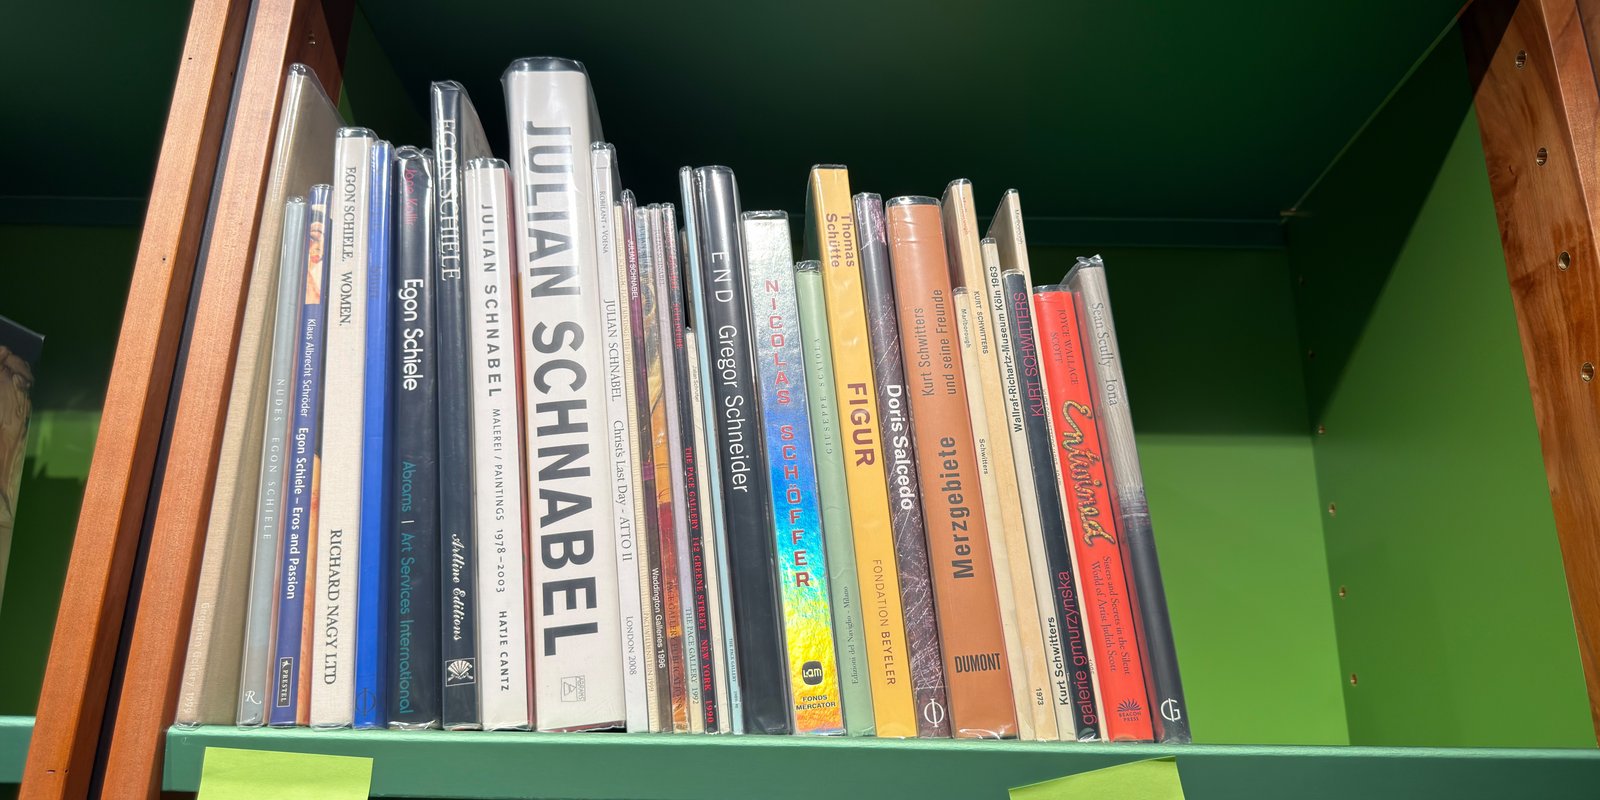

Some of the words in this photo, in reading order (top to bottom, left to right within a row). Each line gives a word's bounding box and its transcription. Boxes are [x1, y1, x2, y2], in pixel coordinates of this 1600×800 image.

[438, 118, 459, 183] EGON
[344, 166, 357, 202] EGON
[525, 121, 582, 298] JULIAN
[598, 190, 607, 223] ROBILANT
[341, 205, 355, 262] SCHIELE.
[440, 187, 462, 281] SCHIELE
[481, 204, 497, 272] JULIAN
[627, 239, 635, 263] JULIAN
[826, 213, 842, 268] Schütte
[840, 213, 855, 268] Thomas
[629, 264, 638, 300] SCHNABEL
[656, 252, 665, 286] SCHNABEL
[711, 252, 734, 303] END
[988, 266, 1000, 289] 1963
[339, 271, 354, 327] WOMEN.
[398, 278, 424, 321] Egon
[933, 289, 948, 334] Freunde
[973, 290, 983, 309] KURT
[993, 289, 1004, 311] Köln
[1091, 302, 1108, 329] Sean
[305, 318, 317, 341] Klaus
[603, 299, 618, 338] JULIAN
[977, 311, 989, 355] SCHWITTERS
[1013, 292, 1037, 377] SCHWITTERS
[1056, 308, 1072, 337] JOYCE
[485, 284, 502, 397] SCHNABEL
[716, 324, 740, 387] Gregor
[914, 307, 931, 368] Schwitters
[940, 338, 954, 369] seine
[1050, 331, 1062, 364] SCOTT
[1093, 331, 1113, 368] Scully
[303, 342, 316, 378] Albrecht
[403, 327, 424, 391] Schiele
[608, 342, 622, 402] SCHNABEL
[996, 312, 1023, 433] Wallraf-Richartz-Museum
[1063, 339, 1079, 385] WALLACE
[274, 378, 287, 422] NUDES
[300, 379, 313, 417] Schröder
[921, 374, 935, 396] Kurt
[944, 374, 957, 395] und
[960, 308, 972, 348] Marlborough
[978, 438, 989, 475] Schwitters
[1026, 382, 1045, 417] KURT
[1105, 378, 1119, 407] Iona
[819, 395, 833, 455] GIUSEPPE
[847, 383, 875, 466] FIGUR
[886, 384, 906, 432] Doris
[295, 427, 309, 454] Egon
[491, 408, 502, 452] MALEREI
[724, 395, 750, 492] Schneider
[765, 280, 791, 404] NICOLAS
[778, 426, 810, 588] SCHÖFFER
[268, 437, 281, 473] EGON
[615, 461, 627, 482] Last
[685, 447, 693, 464] THE
[890, 435, 915, 510] Salcedo
[1062, 399, 1116, 546] Entwined
[293, 457, 307, 494] Schiele
[401, 461, 416, 512] Abrams
[493, 464, 505, 521] PAINTINGS
[532, 321, 599, 657] SCHNABEL
[686, 466, 695, 489] PACE
[262, 481, 277, 541] SCHIELE
[614, 485, 629, 506] Day
[688, 491, 699, 530] GALLERY
[939, 436, 975, 579] Merzgebiete
[291, 506, 303, 530] Eros
[619, 516, 632, 549] ATTO
[289, 532, 301, 554] and
[400, 531, 415, 551] Art
[451, 532, 466, 583] Artline
[622, 552, 632, 561] II
[692, 536, 700, 553] 142
[286, 557, 299, 599] Passion
[327, 529, 343, 601] RICHARD
[694, 555, 705, 592] GREENE
[1090, 561, 1105, 586] World
[1102, 556, 1115, 580] Sisters
[399, 556, 415, 614] Services
[650, 567, 661, 614] Waddington
[843, 586, 851, 609] Milano
[872, 559, 889, 627] FONDATION
[1095, 587, 1107, 598] of
[1107, 581, 1119, 596] and
[325, 605, 339, 649] NAGY
[451, 587, 466, 640] Editions
[498, 610, 509, 647] HATJE
[668, 602, 678, 640] GALLERY
[685, 607, 693, 624] THE
[697, 594, 707, 631] STREET
[1057, 571, 1087, 666] gmurzynska
[1097, 599, 1110, 622] Artist
[1109, 598, 1123, 626] Secrets
[625, 615, 636, 653] LONDON
[655, 614, 664, 648] Galleries
[686, 626, 695, 646] PACE
[1046, 616, 1064, 678] Schwitters
[1099, 623, 1114, 649] Judith
[1114, 627, 1125, 635] in
[1117, 636, 1128, 650] the
[398, 619, 414, 713] International
[628, 655, 637, 675] 2008
[657, 649, 666, 668] 1996
[688, 647, 698, 684] GALLERY
[700, 639, 709, 660] NEW
[848, 644, 856, 655] del
[880, 631, 896, 686] BEYELER
[954, 653, 1001, 673] DUMONT
[1105, 650, 1118, 672] Scott
[1119, 651, 1132, 675] Silent
[280, 669, 290, 702] PRESTEL
[323, 652, 338, 685] LTD
[500, 651, 510, 692] CANTZ
[702, 663, 712, 691] YORK
[850, 657, 860, 684] Edizioni
[183, 692, 196, 715] 1999
[691, 688, 699, 705] 1992
[705, 699, 715, 723] 1990
[795, 701, 836, 710] MERCATOR
[1034, 687, 1045, 706] 1973
[1057, 681, 1069, 706] Kurt
[1073, 670, 1098, 725] galerie
